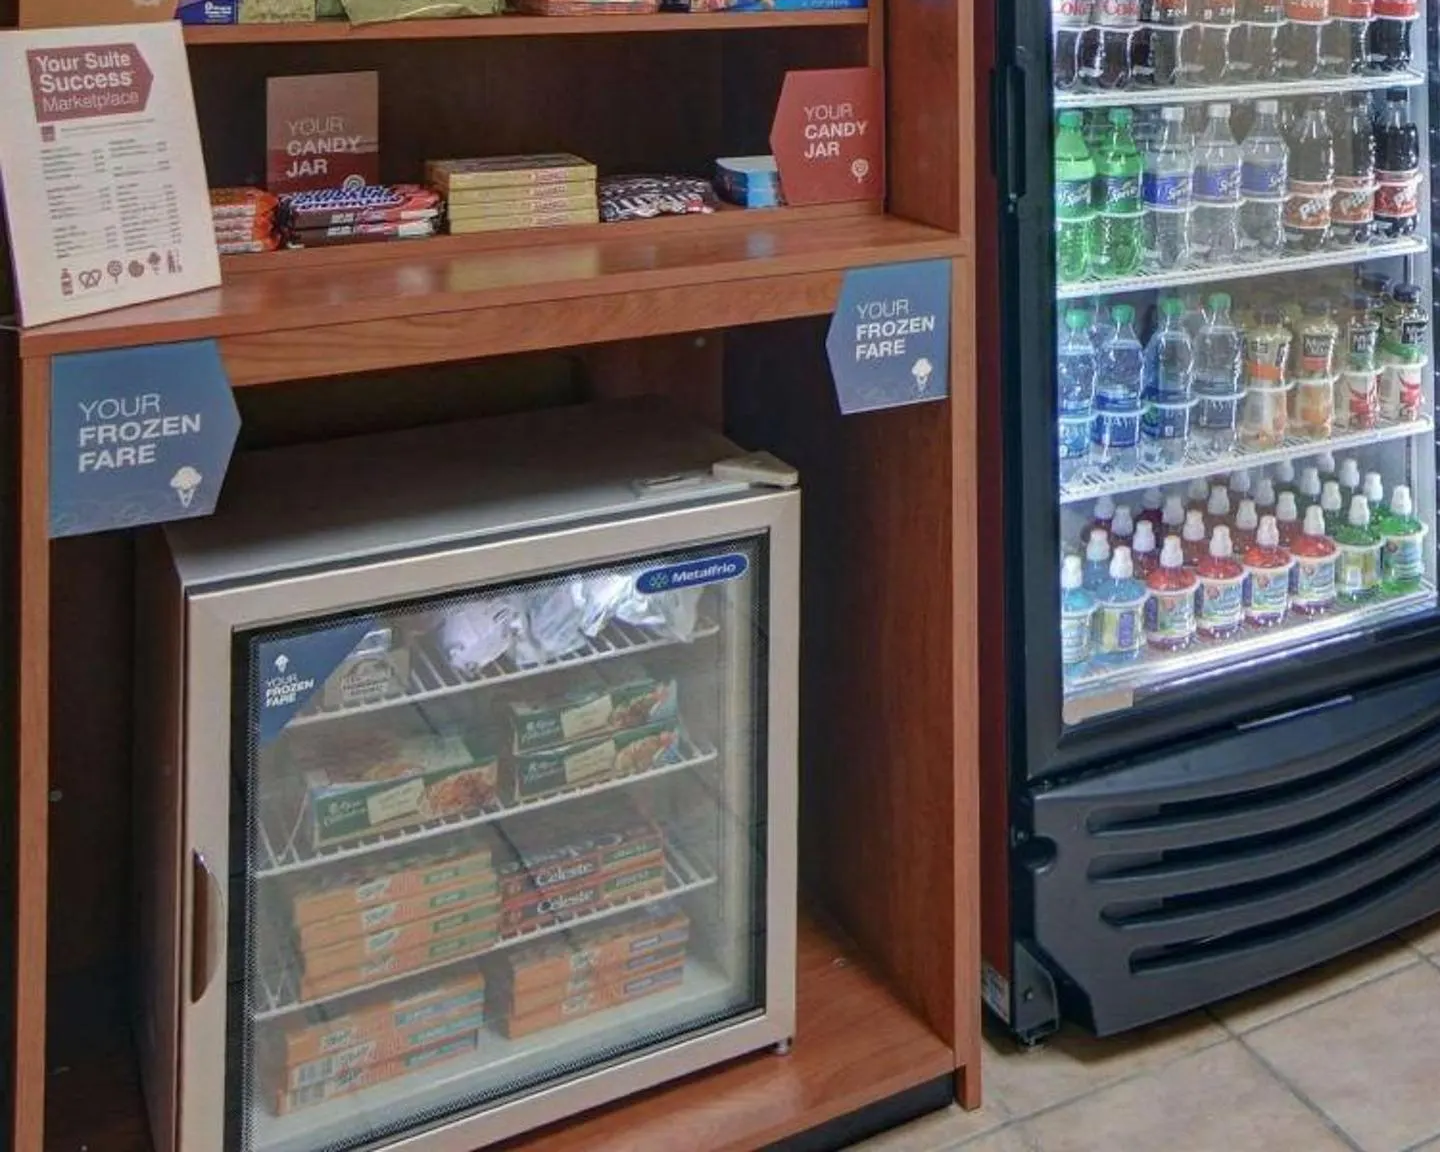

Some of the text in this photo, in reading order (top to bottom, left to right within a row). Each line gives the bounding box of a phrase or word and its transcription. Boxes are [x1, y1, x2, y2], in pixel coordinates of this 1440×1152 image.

[36, 52, 132, 73] Your Suite
[40, 71, 133, 93] Success
[42, 90, 139, 113] Marketplace
[804, 104, 853, 120] YOUR
[285, 116, 344, 134] YOUR
[804, 121, 868, 140] CANDY
[286, 136, 361, 155] CANDY
[804, 141, 841, 159] JAR
[286, 158, 328, 178] JAR
[856, 299, 909, 319] YOUR
[856, 315, 936, 341] FROZEN
[856, 338, 906, 361] FARE
[78, 393, 161, 421] YOUR
[78, 414, 200, 448] FROZEN
[78, 444, 157, 473] FARE
[671, 562, 737, 584] Metalfrio
[266, 680, 314, 699] FROZEN
